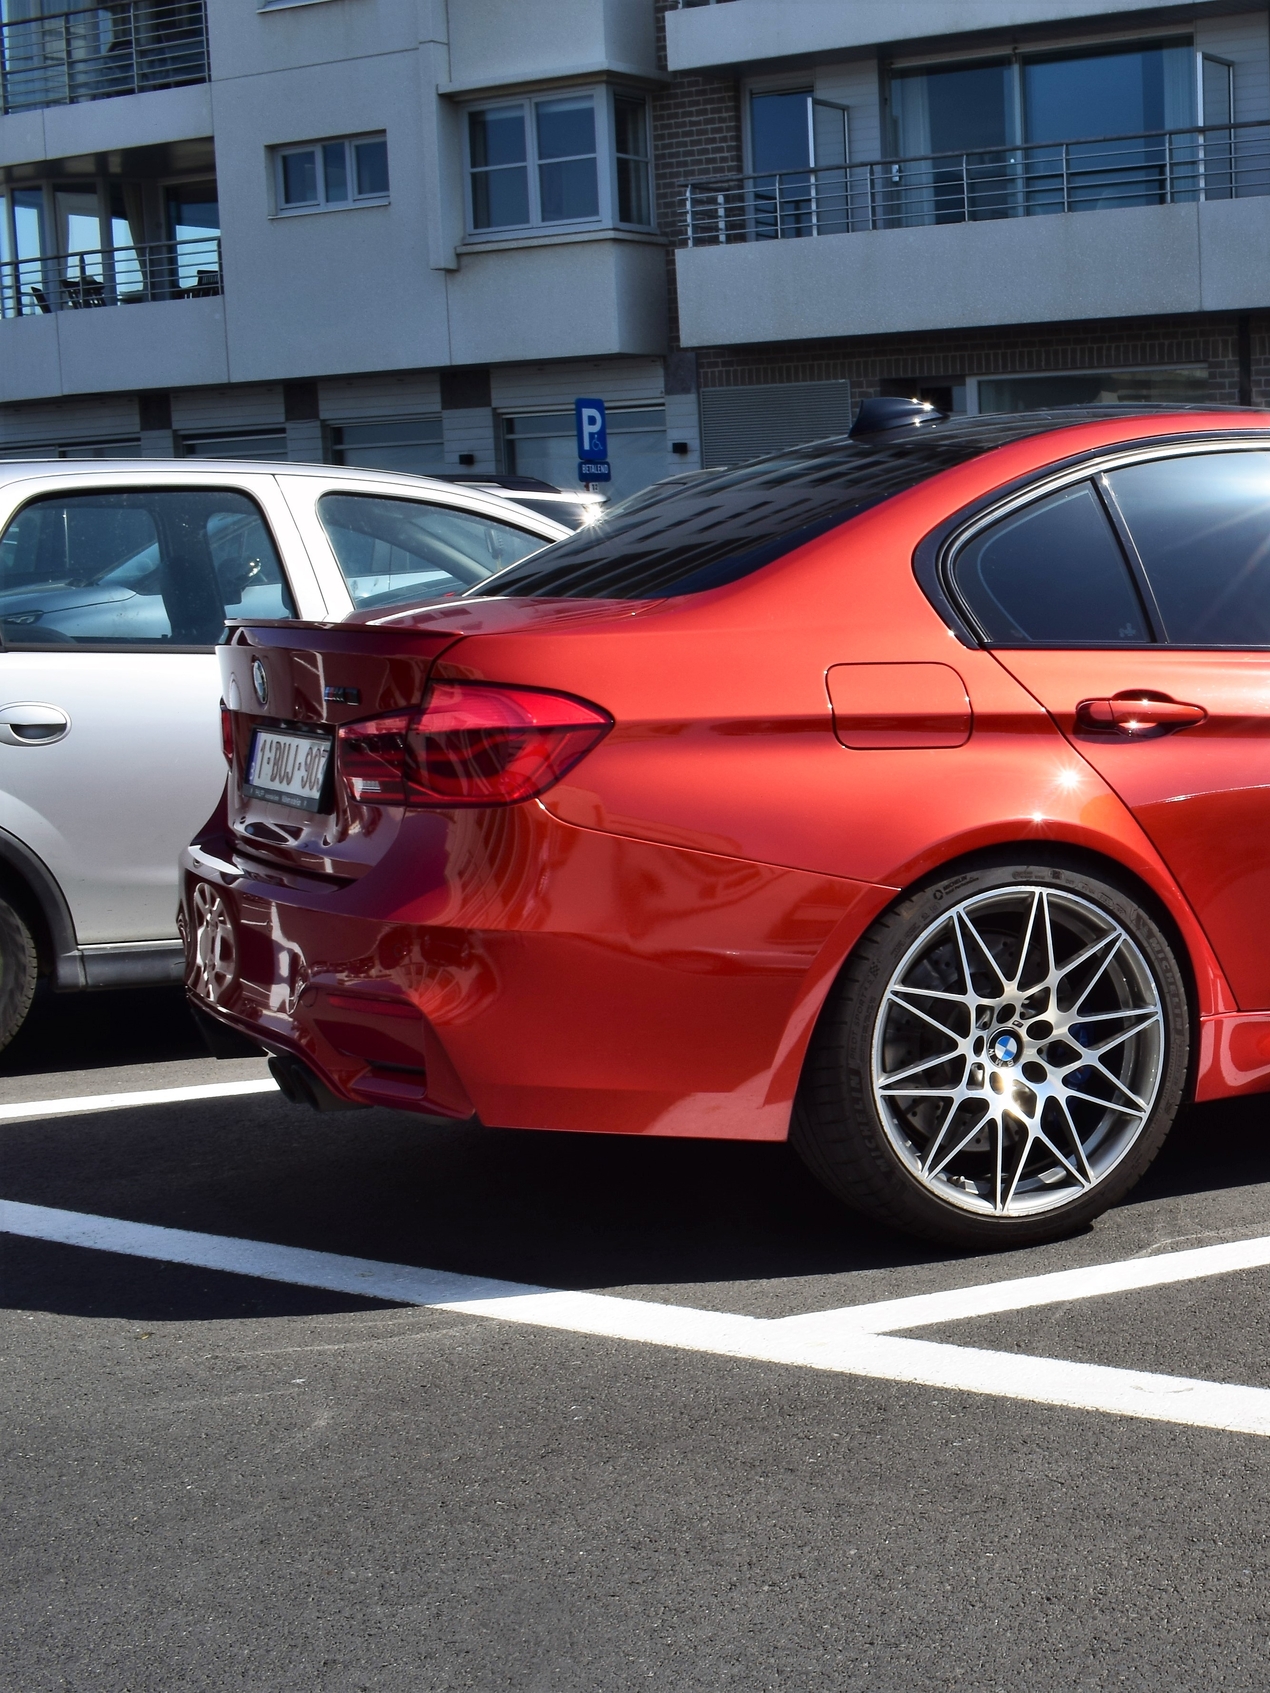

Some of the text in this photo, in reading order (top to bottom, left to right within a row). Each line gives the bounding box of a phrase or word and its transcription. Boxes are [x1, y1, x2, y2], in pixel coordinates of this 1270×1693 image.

[582, 408, 602, 450] P
[582, 464, 609, 474] BETALEND
[853, 994, 867, 1027] SPORT
[850, 1029, 859, 1060] PILOT
[850, 1074, 890, 1173] MICHELIN
